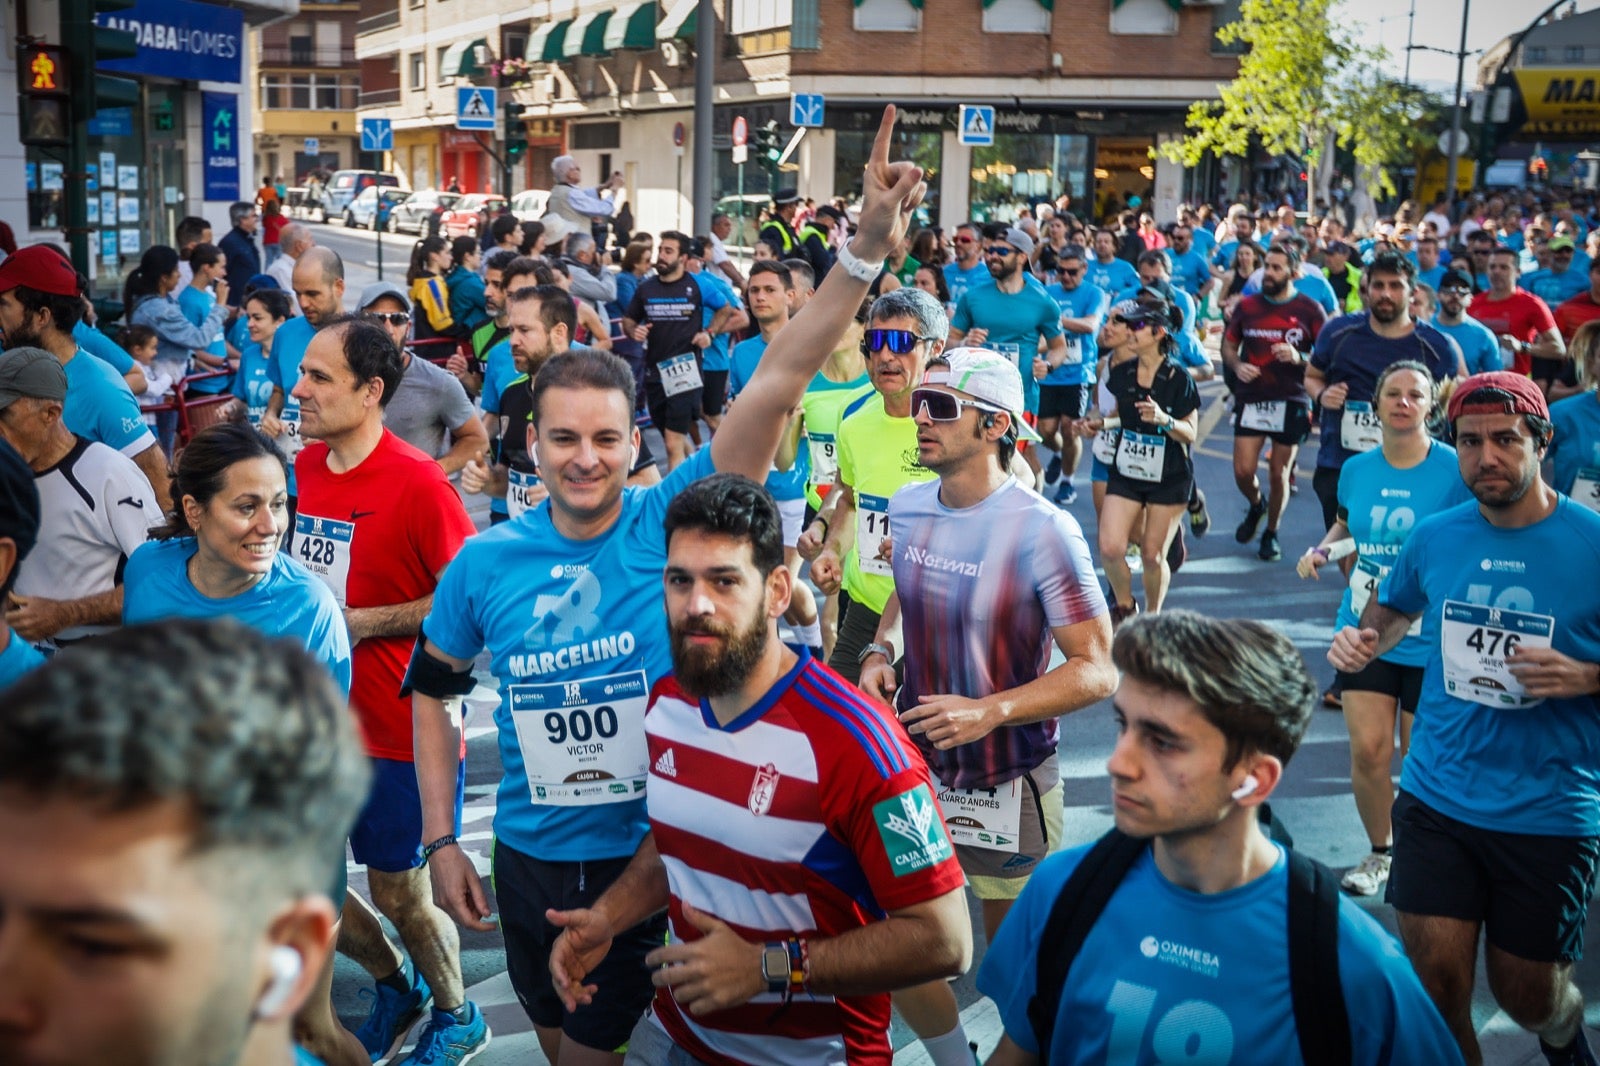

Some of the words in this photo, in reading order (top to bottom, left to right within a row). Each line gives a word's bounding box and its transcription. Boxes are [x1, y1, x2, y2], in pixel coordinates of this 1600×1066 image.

[665, 361, 693, 378] 1113
[1123, 440, 1156, 459] 2441
[300, 536, 336, 566] 428
[1466, 627, 1522, 658] 476
[508, 631, 636, 678] MARCELINO
[543, 705, 619, 744] 900
[566, 743, 605, 757] VICTOR
[971, 796, 1000, 810] ANDRÉS
[895, 850, 921, 866] CAJA
[1161, 940, 1219, 968] OXIMESA
